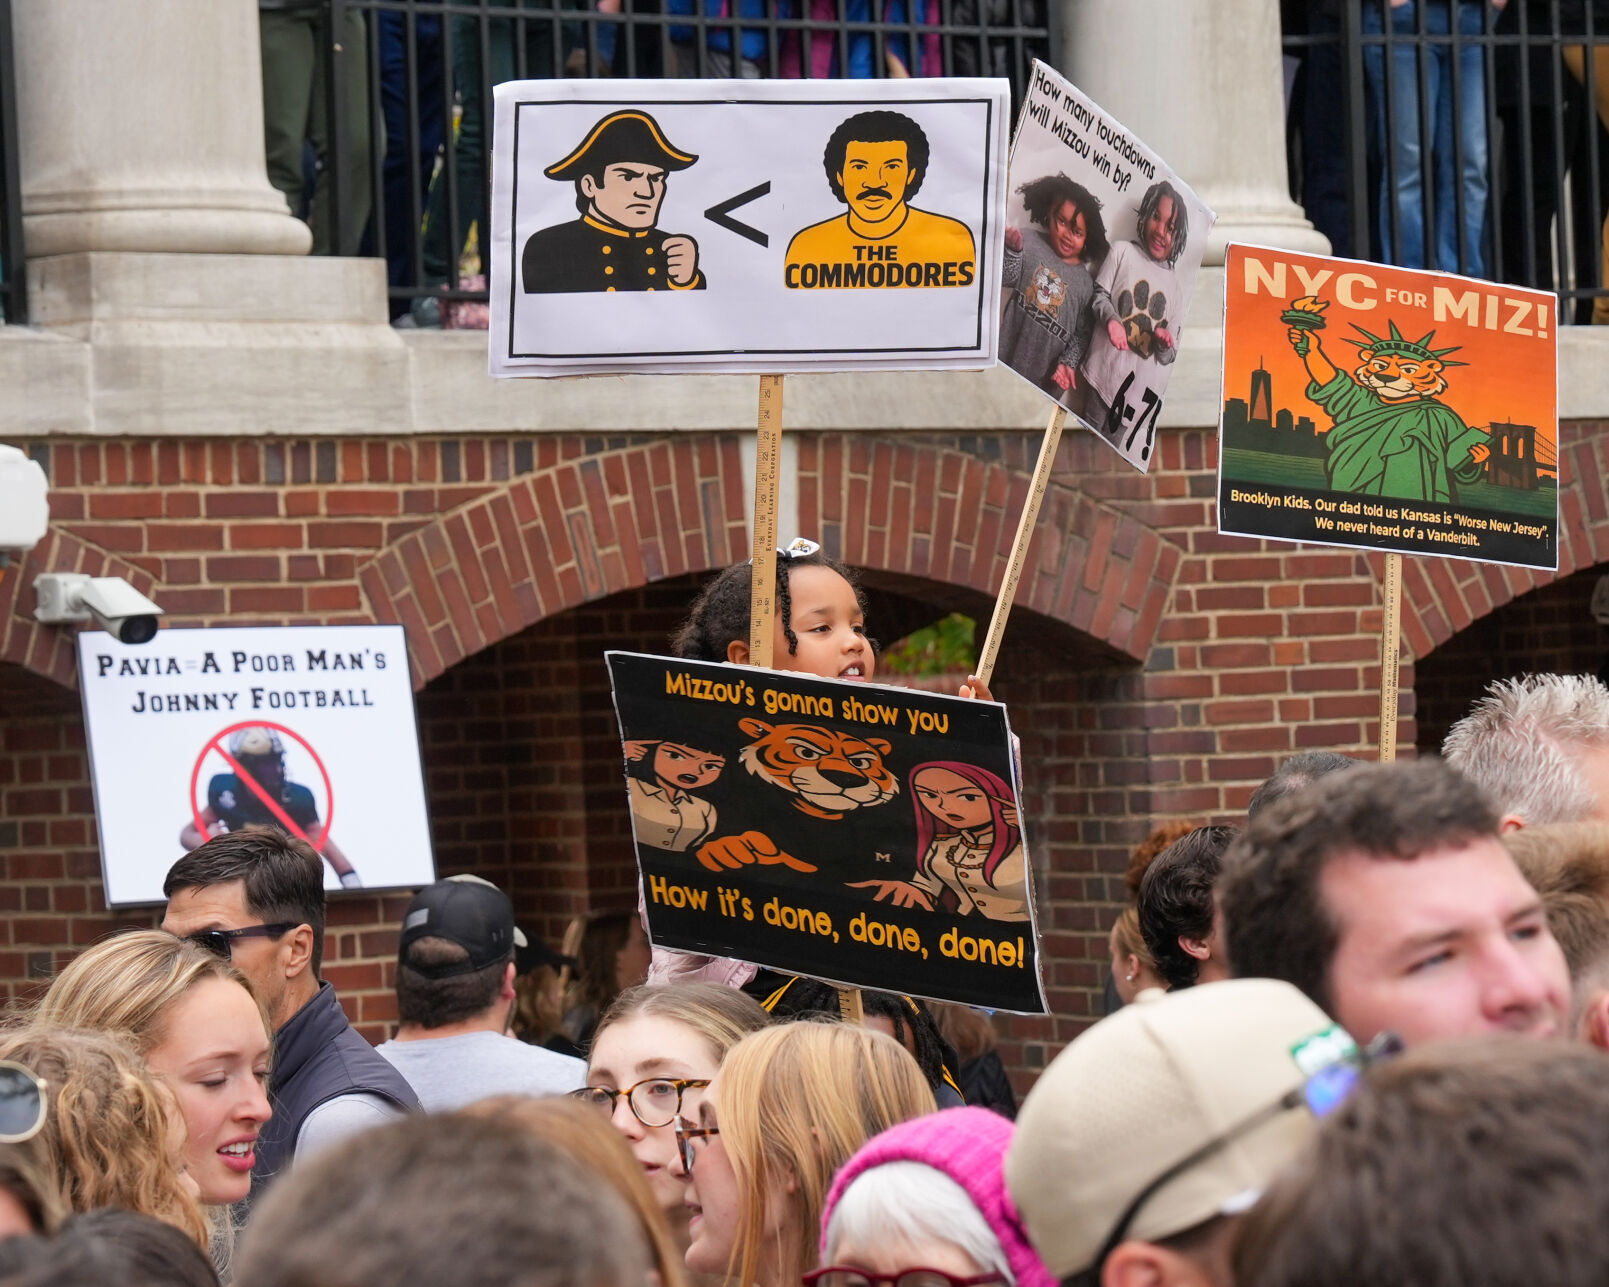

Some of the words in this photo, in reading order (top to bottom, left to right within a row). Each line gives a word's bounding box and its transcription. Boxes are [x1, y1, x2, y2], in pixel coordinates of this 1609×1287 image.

[1029, 100, 1051, 129] will
[1051, 116, 1091, 159] Mizzou
[1093, 150, 1111, 178] win
[1112, 163, 1131, 192] by?
[1035, 72, 1062, 102] How
[1062, 94, 1094, 132] many
[1097, 117, 1156, 180] touchdowns
[785, 261, 974, 289] COMMODORES
[852, 245, 898, 261] THE
[1244, 257, 1378, 311] NYC
[1385, 288, 1427, 309] FOR
[1433, 286, 1548, 339] MIZ!
[1109, 370, 1162, 461] 6-7!
[1231, 489, 1281, 508] Brooklyn
[1284, 495, 1313, 510] Kids.
[1315, 499, 1337, 512] Our
[1339, 501, 1361, 515] dad
[1363, 504, 1383, 518] told
[1386, 508, 1398, 519] us
[1401, 508, 1441, 524] Kansas
[1443, 511, 1452, 524] is
[1489, 519, 1512, 533] New
[1315, 517, 1334, 530] We
[1336, 521, 1369, 534] never
[1370, 522, 1400, 537] heard
[1403, 526, 1416, 538] of
[1417, 530, 1424, 540] a
[1426, 528, 1481, 547] Vanderbilt.
[232, 651, 295, 673] POOR
[131, 691, 238, 713] JOHNNY
[250, 687, 374, 709] FOOTBALL
[665, 670, 755, 706] Mizzou's
[763, 689, 834, 717] gonna
[842, 696, 899, 725] show
[906, 707, 949, 735] you
[875, 852, 891, 863] M
[650, 874, 708, 912] How
[716, 886, 754, 921] it's
[763, 897, 840, 943] done,
[849, 912, 928, 960] done,
[939, 926, 1025, 969] done!
